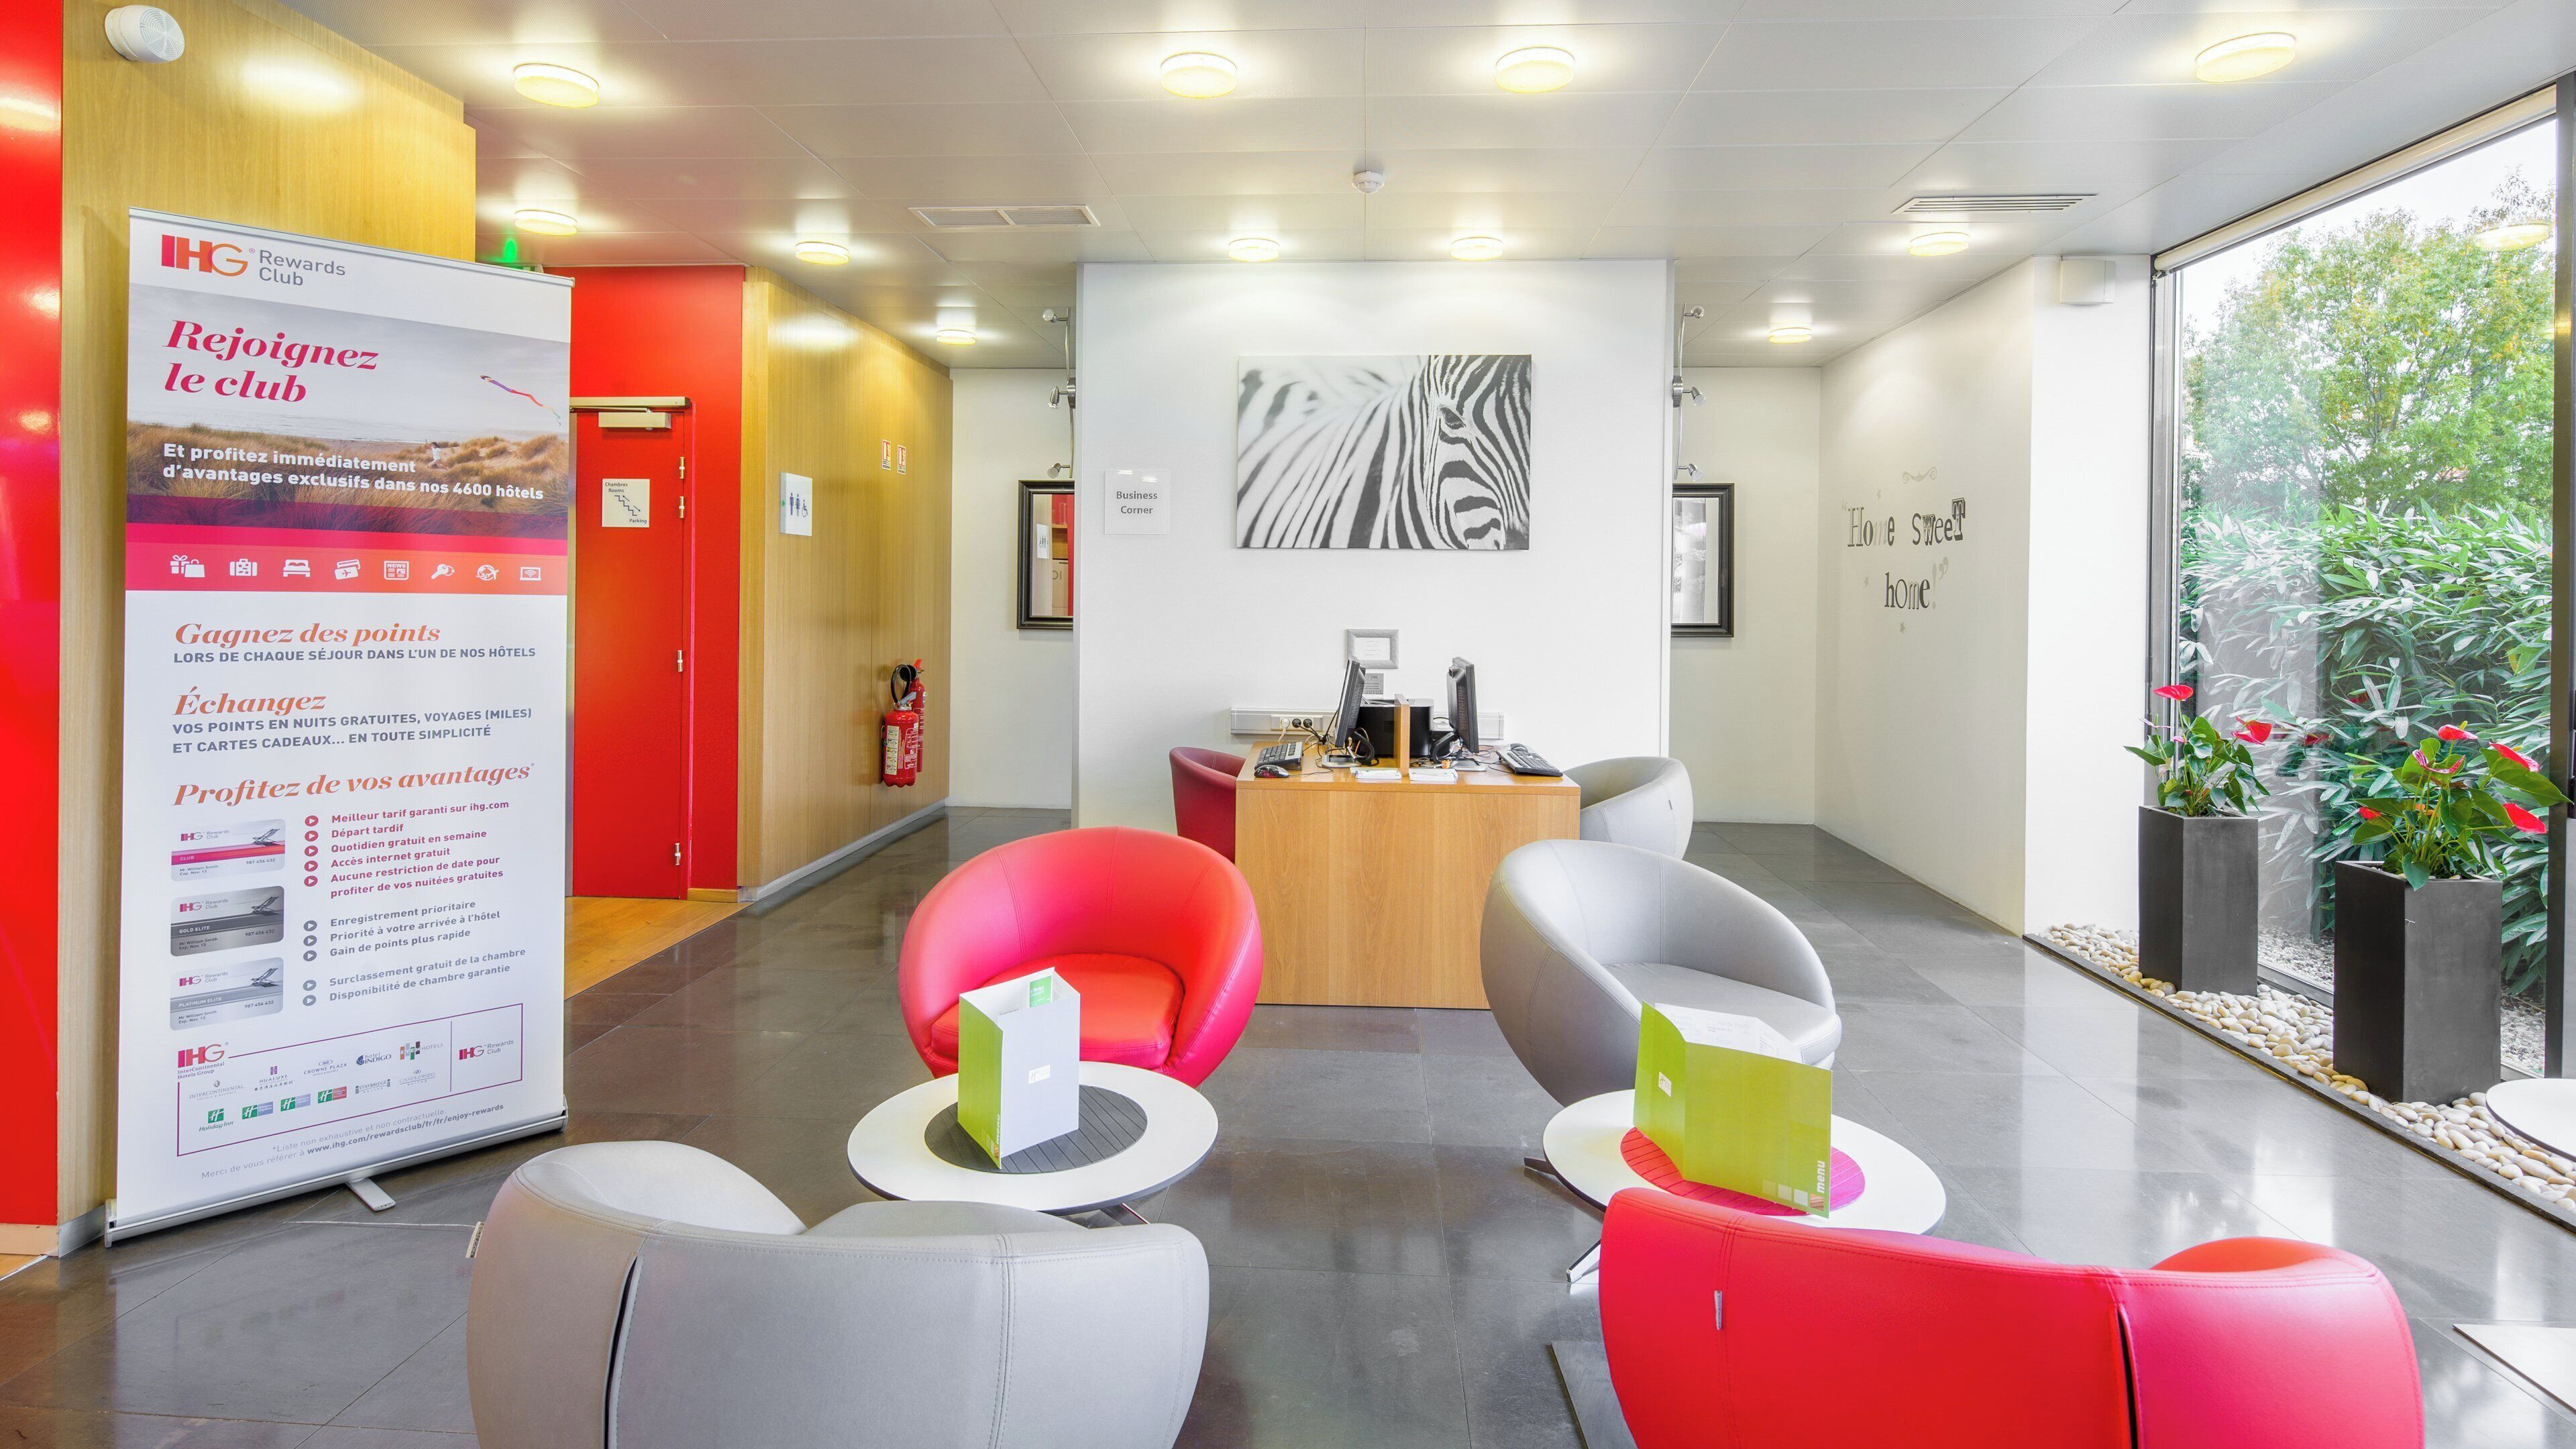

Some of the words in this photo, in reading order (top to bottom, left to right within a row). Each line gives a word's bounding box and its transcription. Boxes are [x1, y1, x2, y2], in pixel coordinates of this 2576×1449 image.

[162, 234, 248, 276] IHG
[259, 249, 345, 276] Rewards
[259, 266, 304, 286] Club
[164, 319, 379, 370] Rejoignez
[164, 362, 205, 393] le
[214, 370, 306, 402] club
[164, 443, 184, 458] Et
[191, 447, 268, 462] profitez
[273, 450, 416, 472] immédiatement
[288, 473, 370, 488] exclusifs
[374, 477, 415, 494] dans
[419, 482, 449, 493] nos
[452, 482, 491, 496] 4600
[496, 484, 543, 499] hôtels
[1116, 491, 1158, 499] Business
[1120, 506, 1153, 514] Corner
[175, 623, 294, 649] Gagnez
[299, 623, 348, 643] des
[351, 623, 440, 647] points
[174, 652, 215, 663] LORS
[219, 651, 239, 662] DE
[243, 650, 304, 661] CHAQUE
[307, 647, 363, 660] SÉJOUR
[367, 649, 405, 659] DANS
[439, 648, 456, 658] DE
[460, 648, 485, 657] NOS
[488, 645, 535, 657] HÔTELS
[172, 686, 326, 715] Échangez
[172, 722, 203, 734] VOS
[207, 720, 264, 733] POINTS
[268, 718, 288, 730] EN
[292, 716, 336, 729] NUITS
[340, 713, 421, 726] GRATUITES,
[423, 710, 481, 722] VOYAGES
[485, 708, 531, 720] (MILES)
[172, 742, 193, 753] ET
[197, 739, 258, 752] CARTES
[348, 733, 367, 743] EN
[370, 731, 415, 742] TOUTE
[418, 724, 491, 739] SIMPLICITÉ
[172, 779, 301, 806] Profitez
[306, 773, 340, 795] de
[345, 775, 392, 792] vos
[331, 812, 380, 823] Meilleur
[382, 808, 407, 818] tarif
[409, 805, 447, 818] garanti
[470, 801, 509, 812] ihg.com
[181, 832, 203, 841] IHG
[331, 826, 370, 839] Départ
[372, 823, 404, 834] tardif
[331, 840, 384, 853] Quotidien
[387, 836, 425, 849] gratuit
[443, 830, 487, 841] semaine
[330, 856, 363, 868] Accès
[366, 851, 411, 863] internet
[414, 847, 450, 860] gratuit
[330, 871, 372, 882] Aucune
[375, 864, 433, 877] restriction
[435, 862, 449, 870] de
[451, 859, 474, 868] date
[476, 857, 500, 867] pour
[330, 885, 374, 899] profiter
[377, 882, 390, 891] de
[393, 881, 412, 889] vos
[415, 875, 454, 887] nuitées
[456, 870, 503, 883] gratuites
[180, 902, 202, 912] IHG
[330, 908, 418, 924] Enregistrement
[421, 901, 476, 916] prioritaire
[329, 926, 374, 942] Priorité
[376, 925, 383, 934] à
[386, 924, 415, 933] votre
[417, 916, 457, 929] arrivée
[459, 914, 465, 923] à
[329, 946, 355, 956] Gain
[358, 943, 372, 952] de
[374, 938, 409, 951] points
[411, 935, 435, 947] plus
[437, 929, 470, 941] rapide
[329, 965, 413, 986] Surclassement
[415, 959, 452, 974] gratuit
[454, 957, 467, 966] de
[470, 955, 479, 963] la
[482, 949, 525, 961] chambre
[179, 975, 201, 987] IHG
[329, 980, 400, 1001] Disponibilité
[402, 979, 417, 988] de
[419, 972, 465, 986] chambre
[467, 964, 510, 979] garantie
[178, 1000, 206, 1008] PLATINUM
[178, 1044, 225, 1068] IHG
[421, 1042, 443, 1051] HOTELS
[459, 1045, 484, 1061] IHG
[487, 1040, 515, 1049] Rewards
[177, 1061, 225, 1075] InterContinental
[365, 1054, 392, 1064] INDIGO
[177, 1072, 196, 1080] Hotels
[197, 1069, 215, 1077] Group
[304, 1067, 327, 1075] CROWNE
[199, 1123, 223, 1132] Holiday
[300, 1138, 316, 1146] non
[318, 1128, 363, 1141] exhaustive
[376, 1122, 390, 1130] non
[392, 1109, 447, 1126] contractuelle.
[201, 1169, 227, 1179] Merci
[243, 1161, 264, 1169] vous
[267, 1152, 295, 1163] référer
[307, 1104, 504, 1154] www.ihg.com/rewardsclub/fr/fr/enjoy-rewards
[1817, 1160, 1825, 1193] menu
